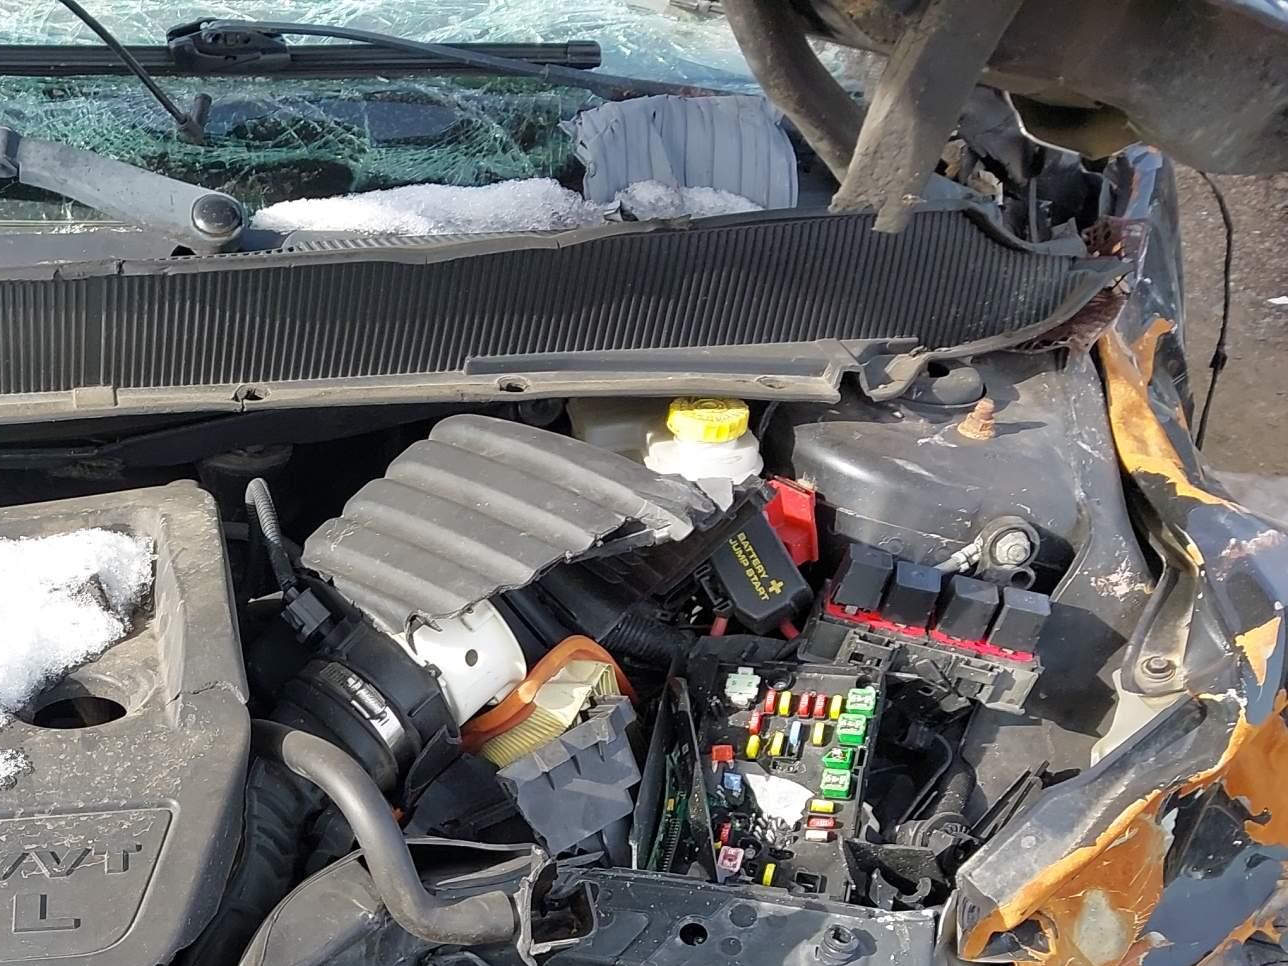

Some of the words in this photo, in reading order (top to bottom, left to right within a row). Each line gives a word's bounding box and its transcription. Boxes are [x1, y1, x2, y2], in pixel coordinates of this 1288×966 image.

[728, 538, 750, 567] JUMP
[745, 568, 770, 600] START
[737, 532, 769, 579] BATTERY
